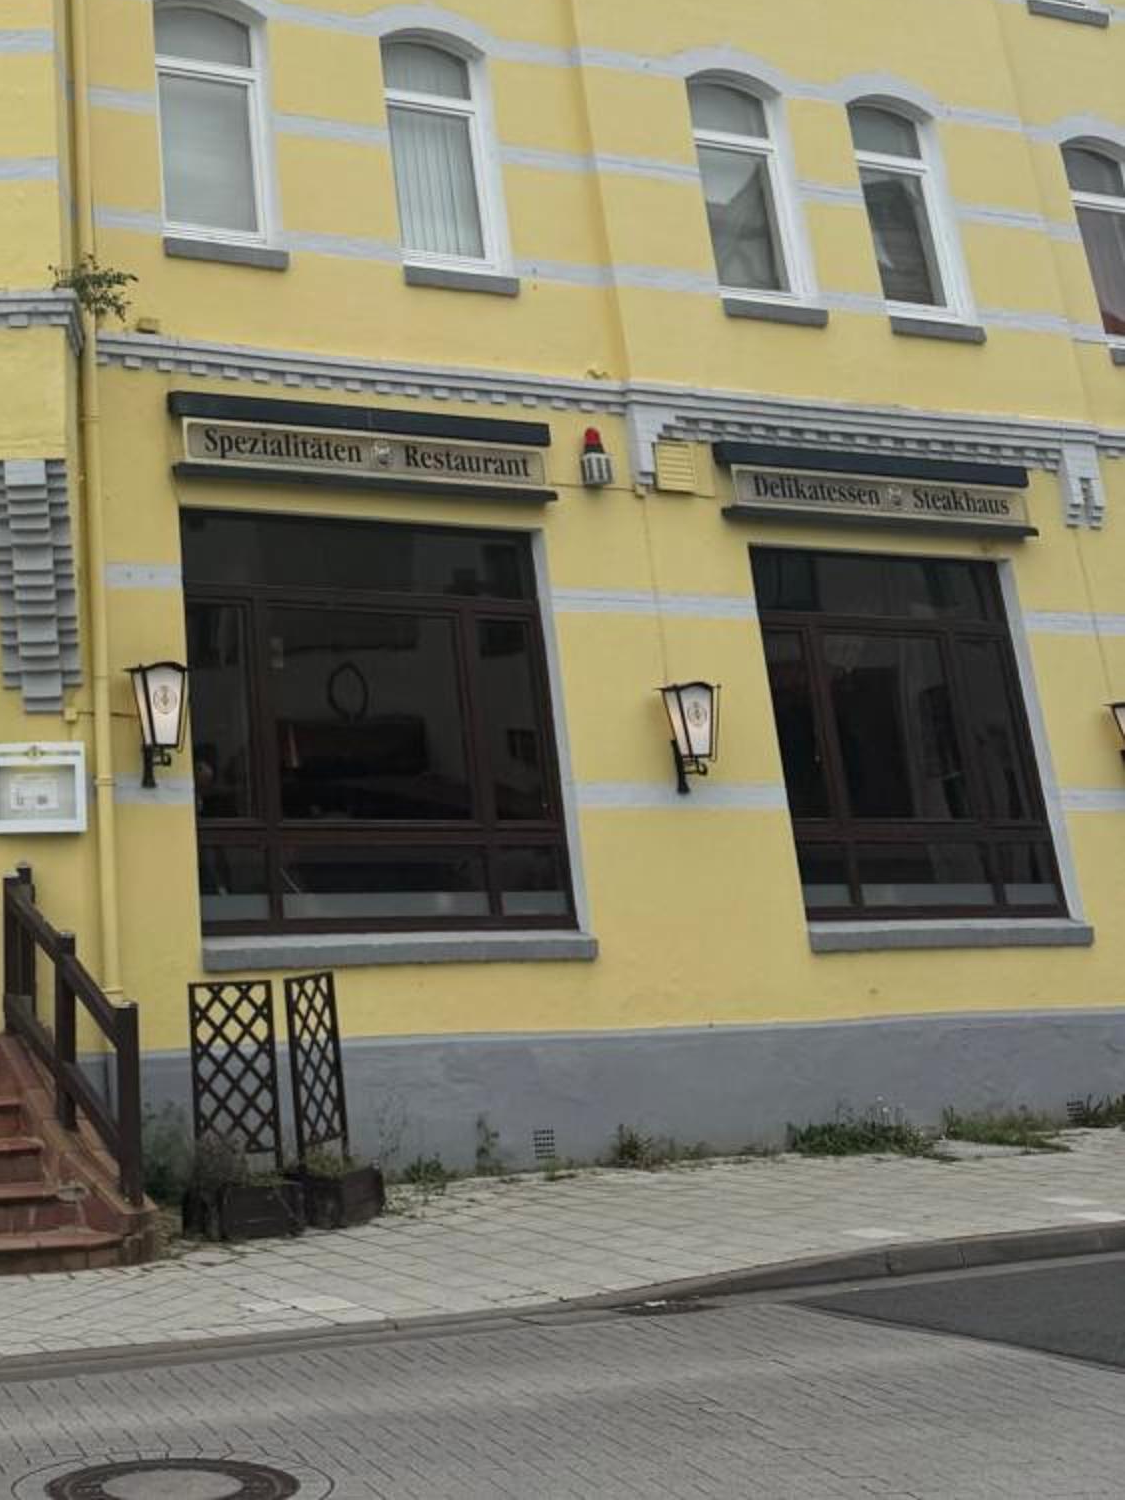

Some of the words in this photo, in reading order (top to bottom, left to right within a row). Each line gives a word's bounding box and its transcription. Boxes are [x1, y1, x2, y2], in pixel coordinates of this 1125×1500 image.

[203, 426, 363, 464] Spezialitäten
[403, 444, 531, 478] Restaurant
[753, 474, 881, 506] Delikatessen
[911, 486, 1011, 515] Steakhaus
